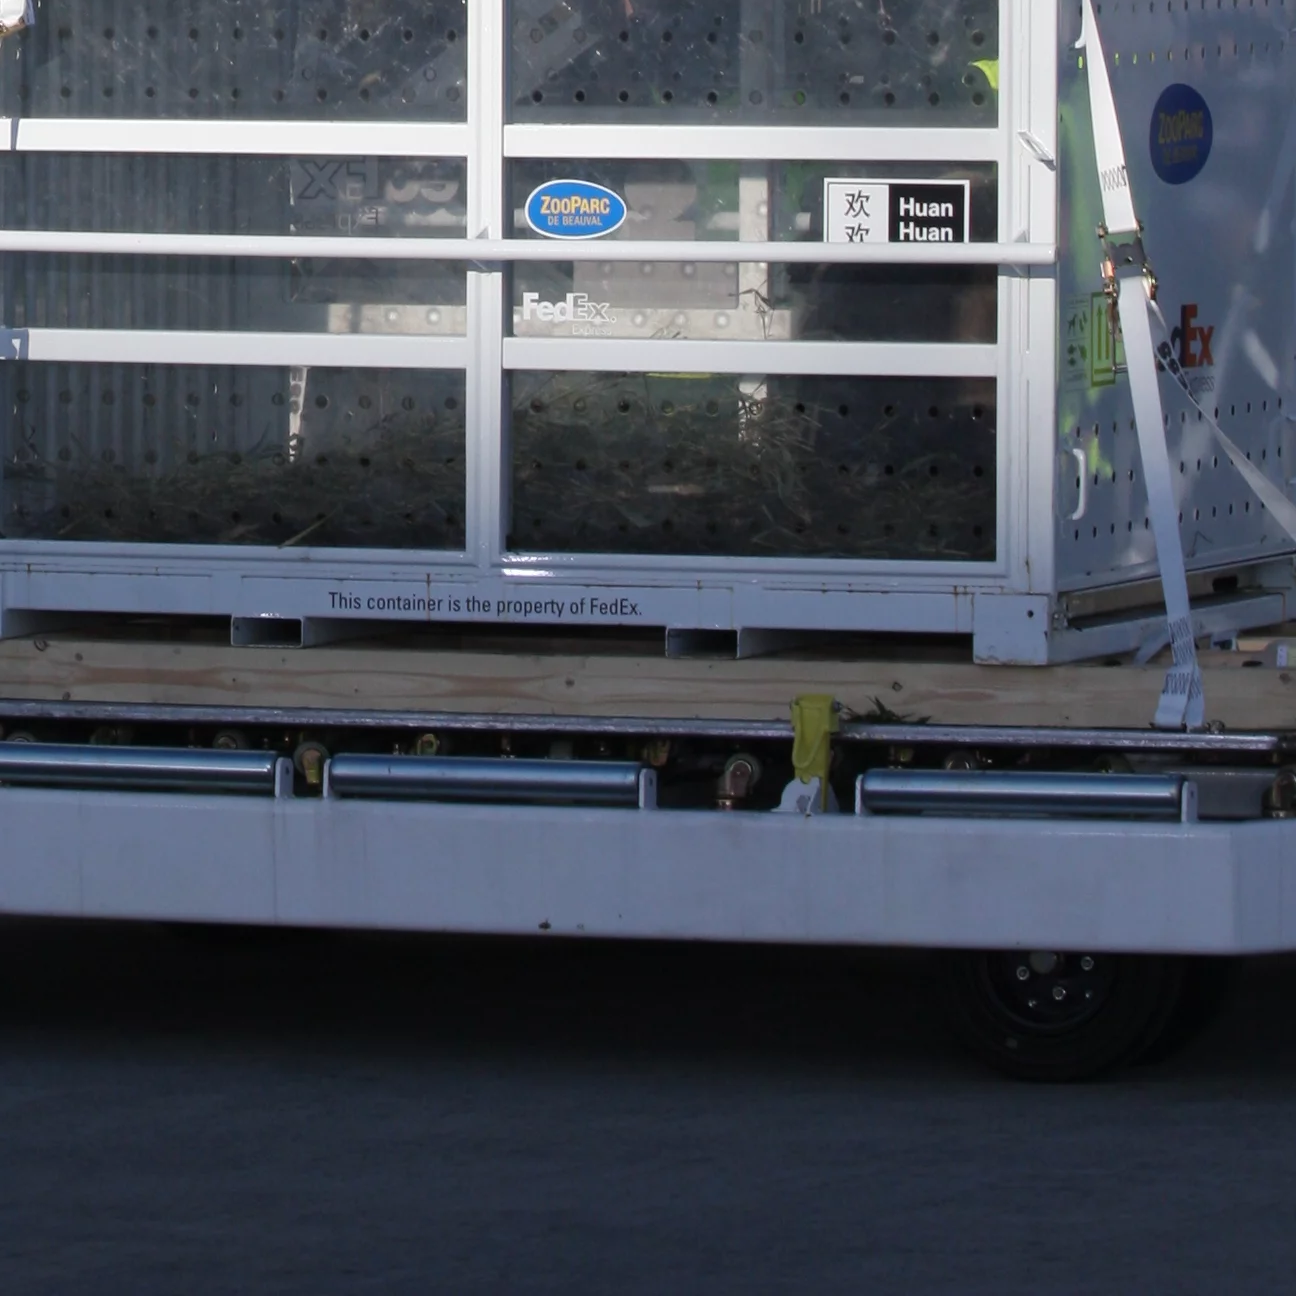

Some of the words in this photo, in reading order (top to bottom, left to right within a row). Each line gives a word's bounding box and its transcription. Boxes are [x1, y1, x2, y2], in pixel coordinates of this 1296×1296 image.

[899, 197, 953, 217] Huan
[547, 216, 560, 227] DE
[562, 216, 603, 227] BEAUVAL
[899, 222, 953, 242] Huan
[328, 592, 362, 609] This
[367, 593, 444, 611] container
[448, 595, 461, 612] is
[465, 594, 491, 613] the
[496, 598, 564, 618] property
[569, 598, 587, 615] of
[590, 598, 643, 616] FedEx.
